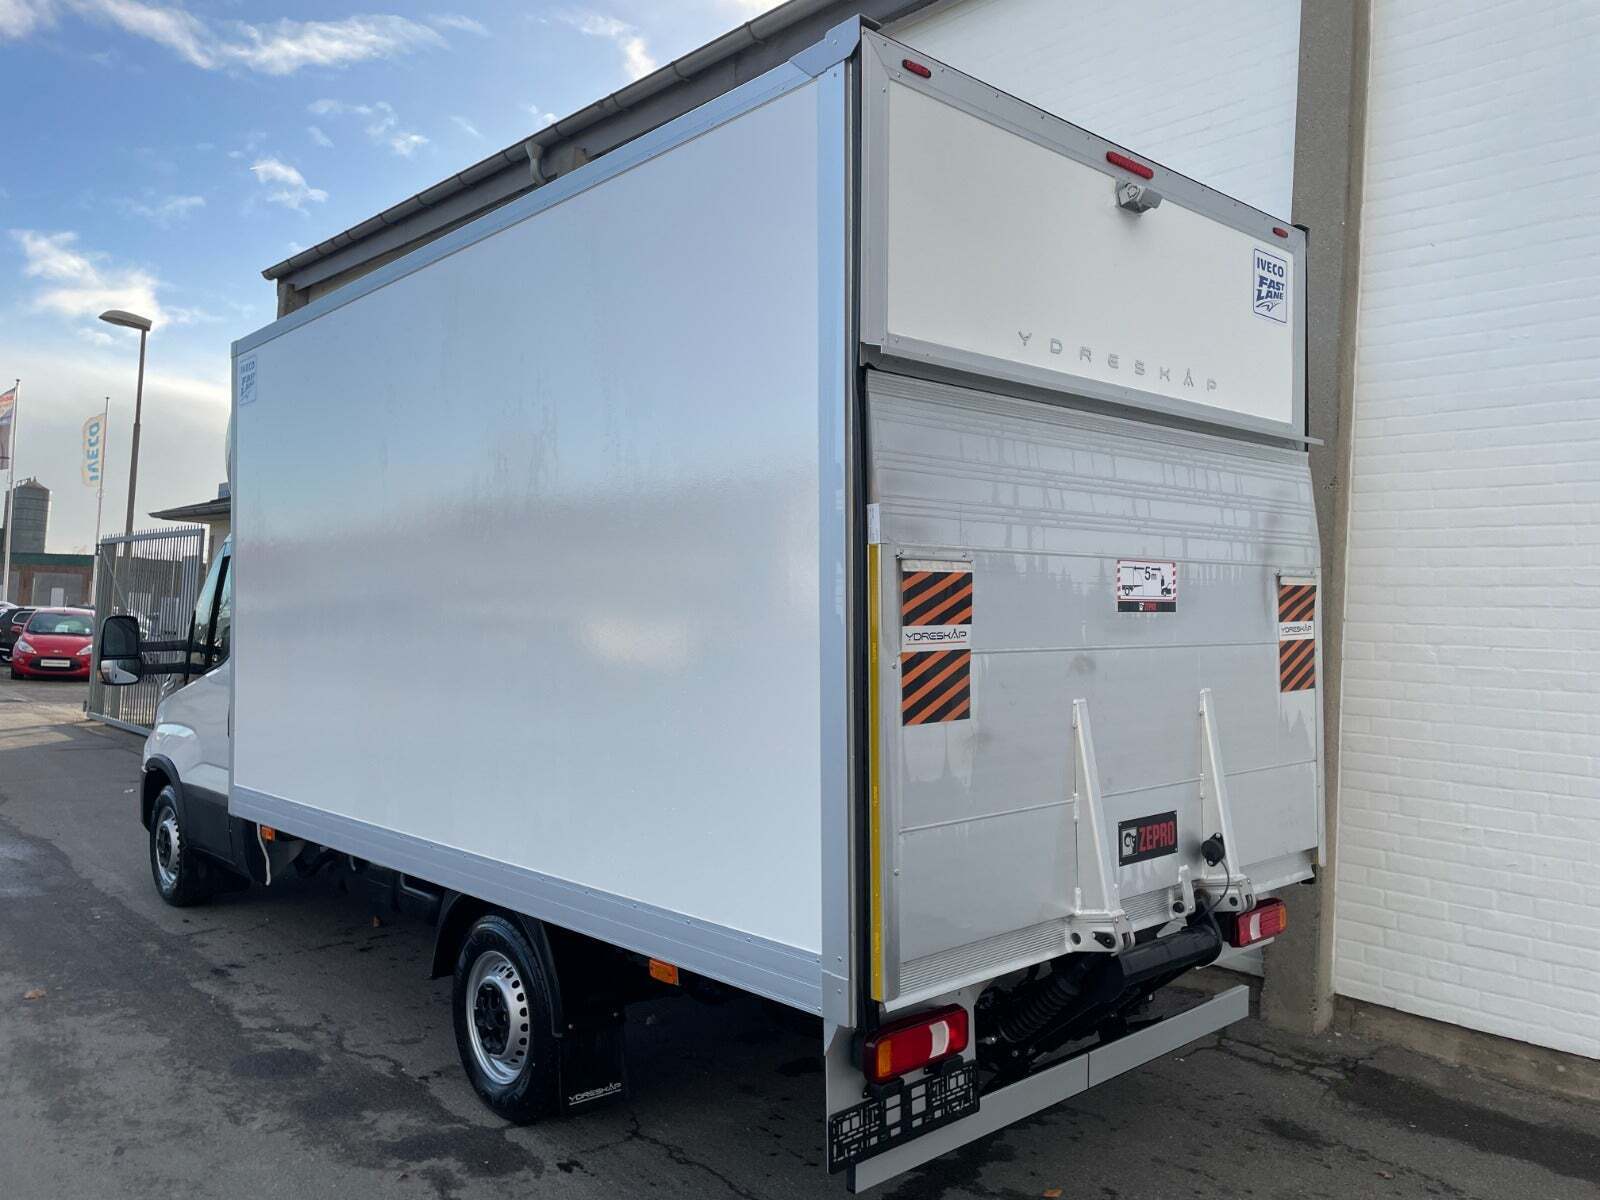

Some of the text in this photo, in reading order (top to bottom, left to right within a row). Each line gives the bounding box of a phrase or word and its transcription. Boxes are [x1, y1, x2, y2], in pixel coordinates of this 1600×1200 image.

[1257, 257, 1284, 278] IVECO
[1259, 275, 1285, 291] FAST
[1256, 289, 1284, 301] LANE
[87, 422, 100, 481] IVECO
[905, 628, 967, 641] YDRESKÅP
[1138, 820, 1175, 852] ZEPRO
